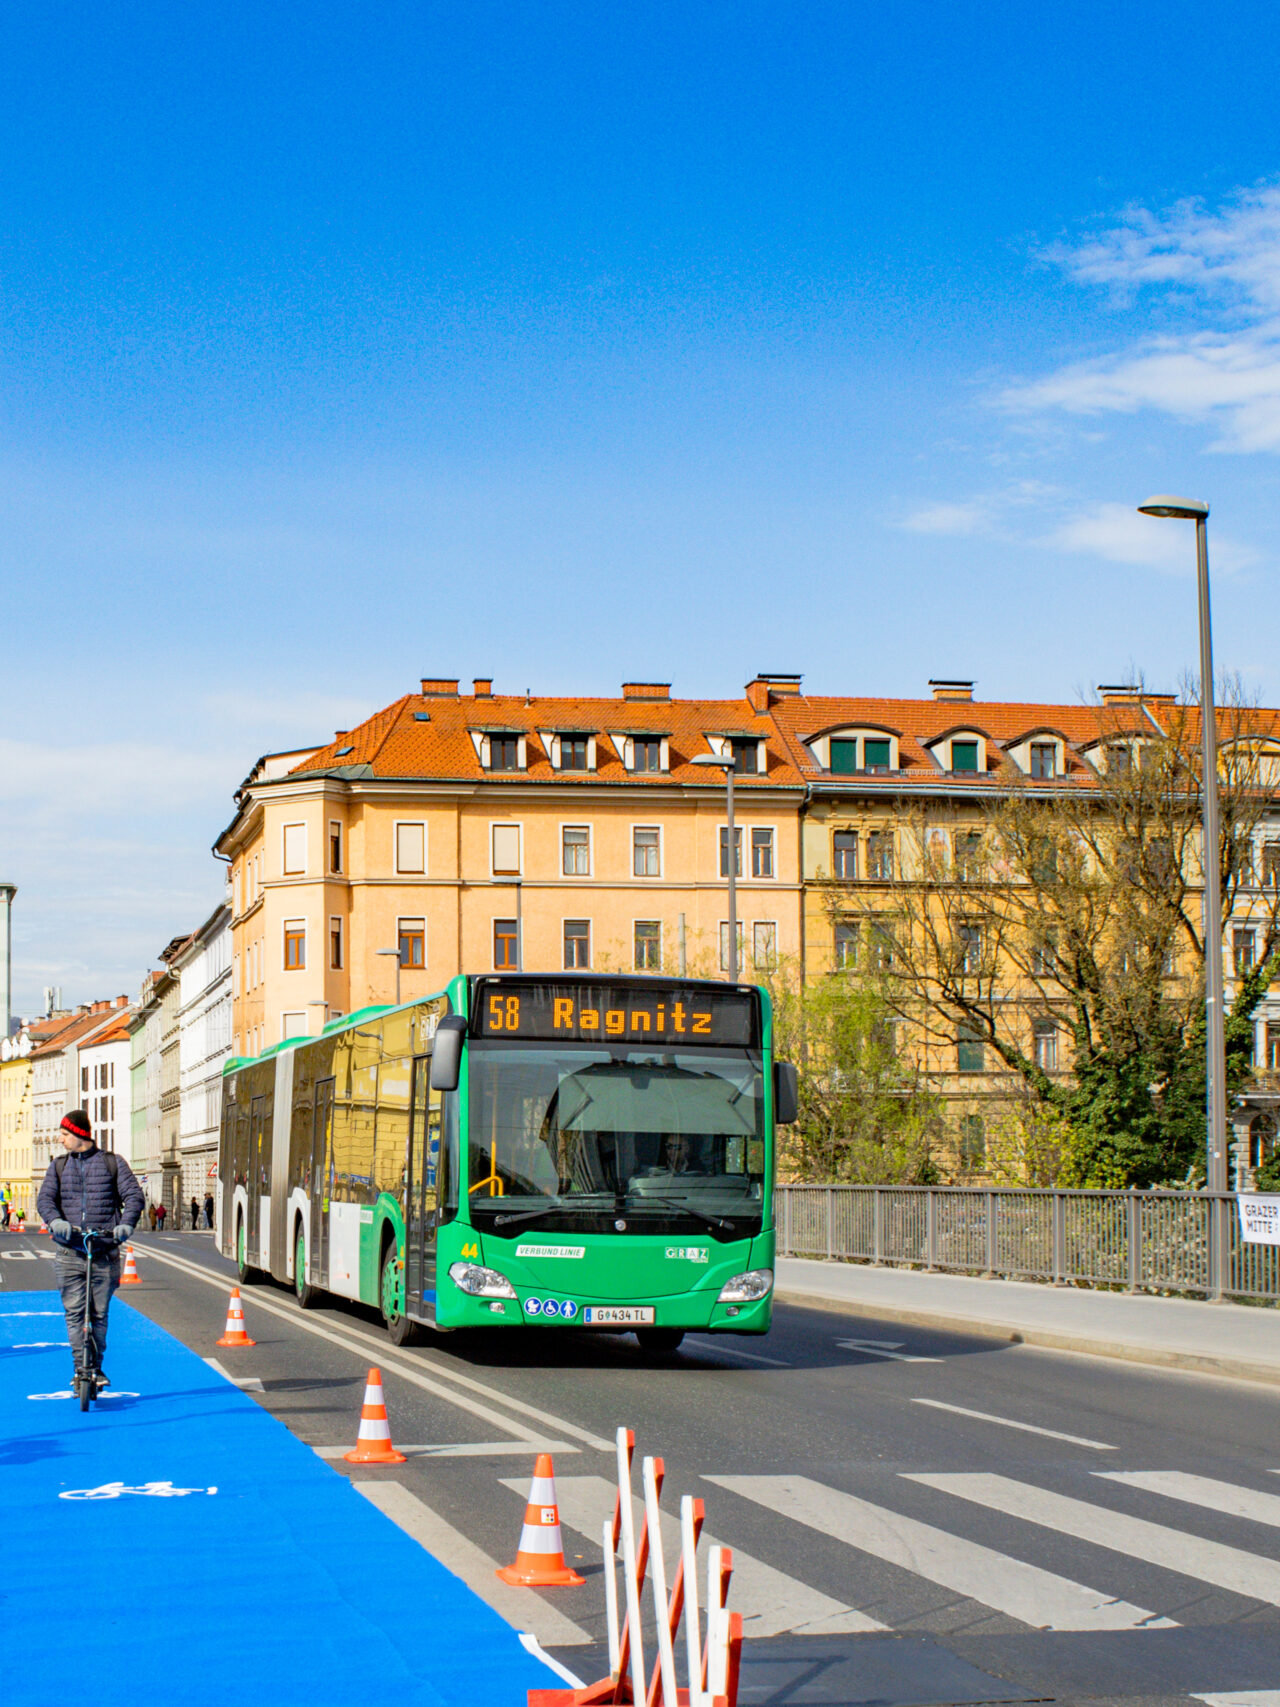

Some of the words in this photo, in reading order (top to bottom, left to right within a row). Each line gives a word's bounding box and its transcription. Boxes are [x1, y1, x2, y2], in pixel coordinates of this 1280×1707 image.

[489, 995, 520, 1031] 58
[553, 997, 712, 1034] Ragnitz
[1245, 1204, 1278, 1218] GRAZER
[1246, 1219, 1273, 1233] MITTE
[460, 1242, 478, 1258] 44
[520, 1247, 559, 1256] VERBUND
[559, 1248, 582, 1257] LINIE
[665, 1247, 708, 1259] GRAZ
